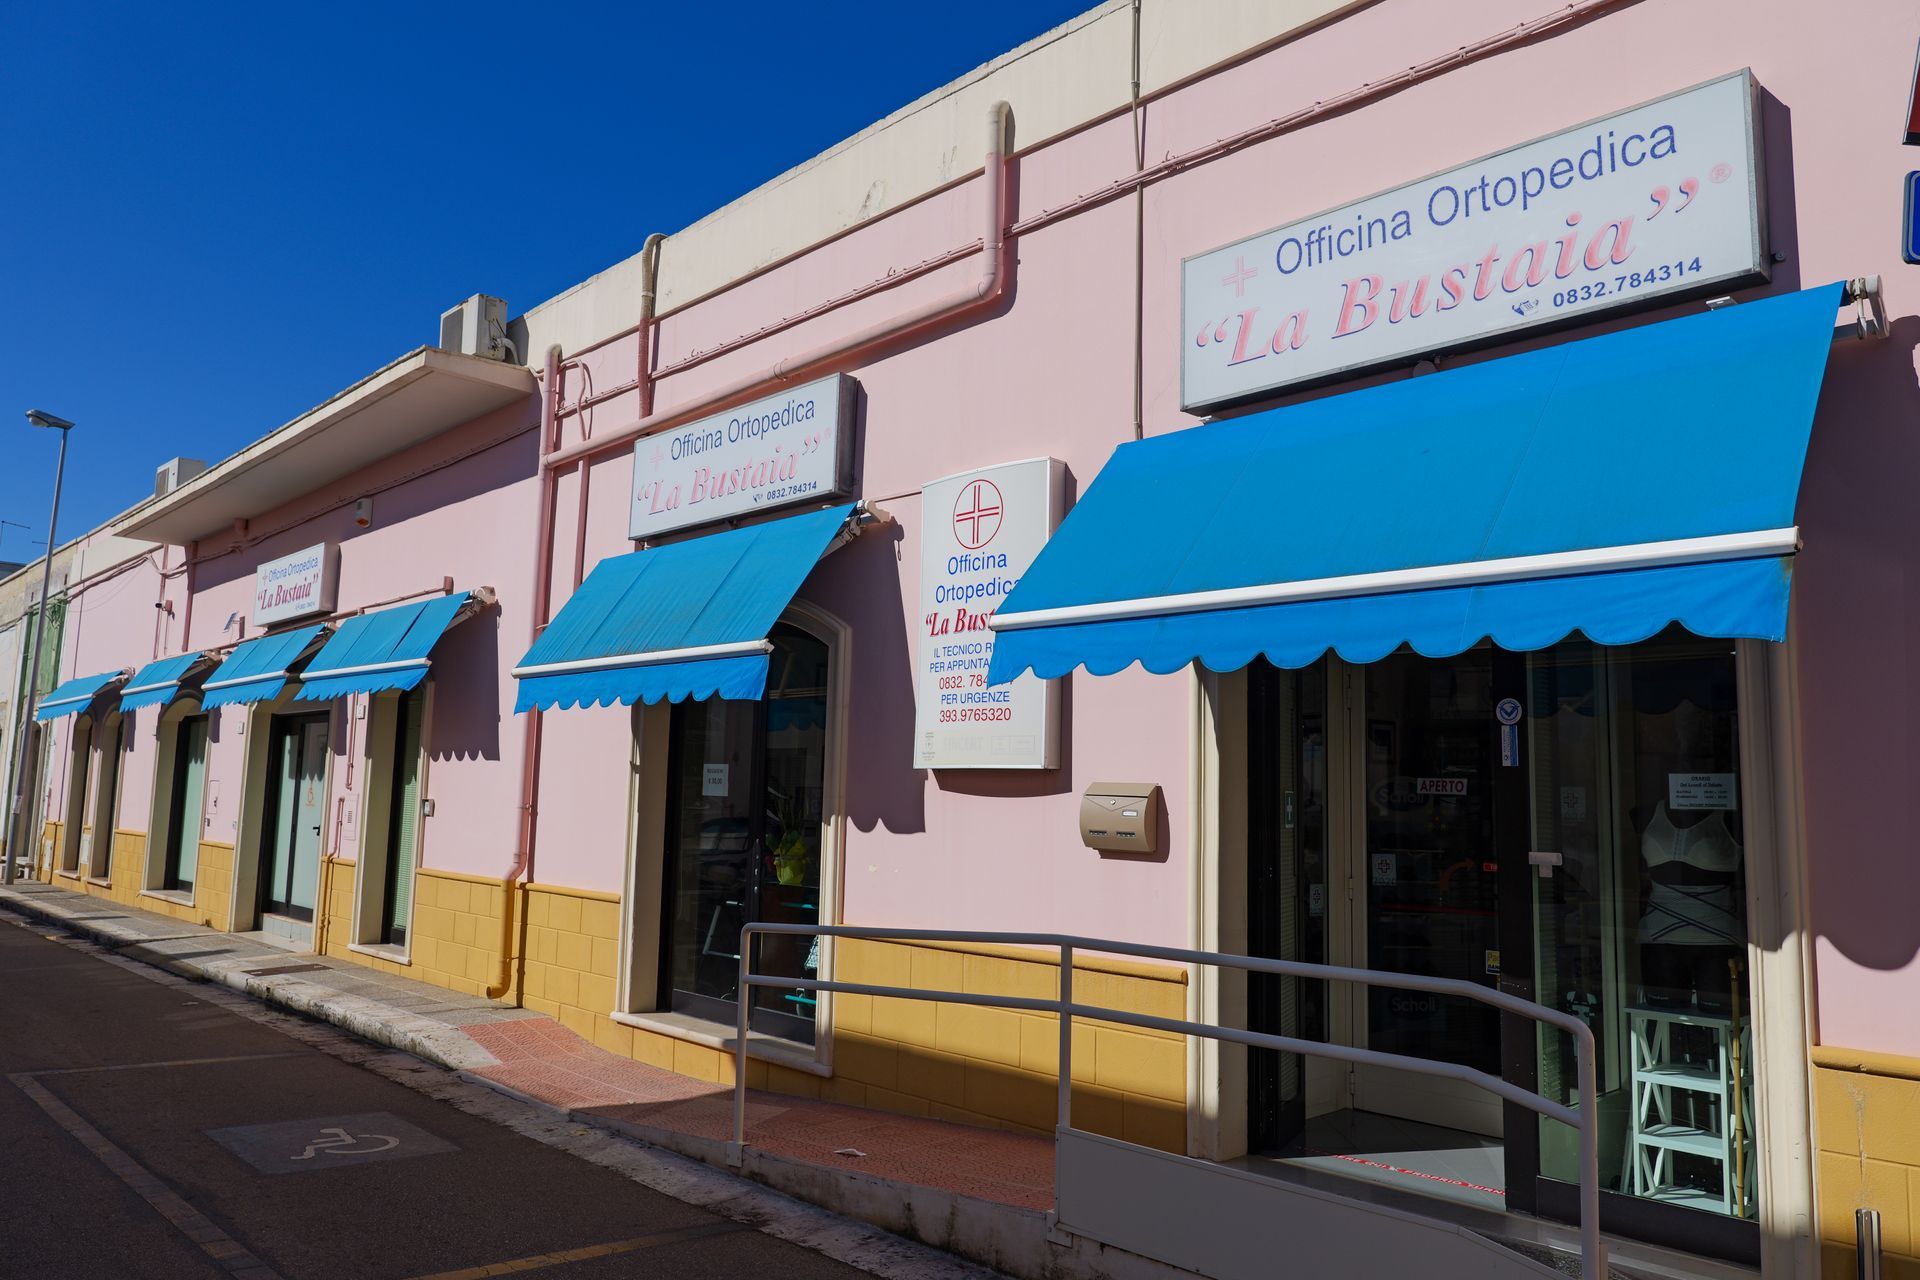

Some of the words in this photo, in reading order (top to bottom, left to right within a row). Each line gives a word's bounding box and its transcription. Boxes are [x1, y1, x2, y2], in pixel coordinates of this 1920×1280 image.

[1276, 203, 1412, 276] Officina
[1427, 124, 1678, 228] Ortopedica
[1552, 256, 1703, 309] 0832.784314
[671, 429, 723, 461] Officina
[728, 400, 815, 444] Ortopedica
[766, 480, 818, 501] 0832.784314
[268, 569, 287, 582] Officina
[288, 557, 318, 576] Ortopedica
[947, 552, 1008, 575] Officina
[953, 607, 996, 634] Bust
[933, 648, 941, 658] IL
[942, 643, 983, 657] TECNICO
[929, 662, 945, 673] PER
[947, 658, 990, 671] APPUNTA
[939, 675, 966, 690] 0832.
[941, 692, 958, 705] PER
[960, 690, 1010, 704] URGENZE
[939, 708, 1012, 723] 393.9765320
[1420, 780, 1464, 793] APERTO
[1391, 996, 1436, 1013] Scholl
[1467, 1183, 1504, 1196] TURN
